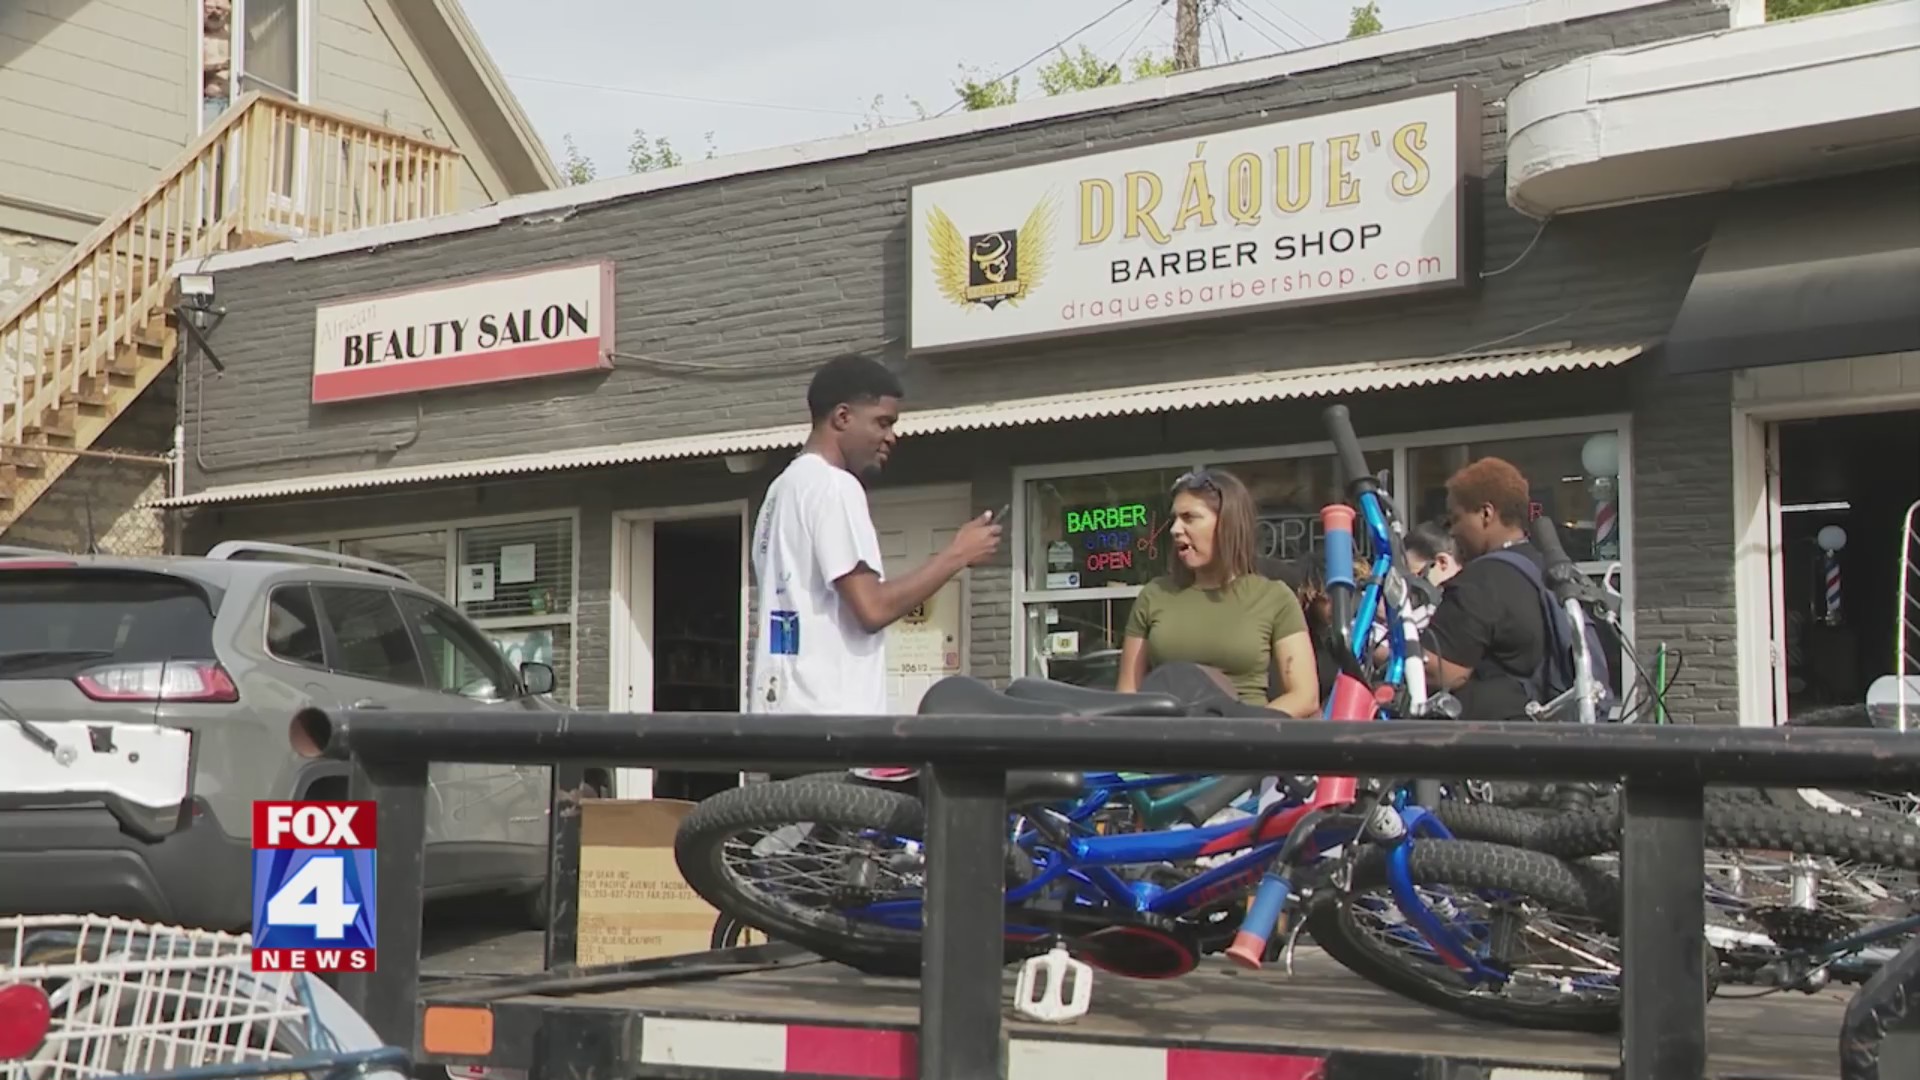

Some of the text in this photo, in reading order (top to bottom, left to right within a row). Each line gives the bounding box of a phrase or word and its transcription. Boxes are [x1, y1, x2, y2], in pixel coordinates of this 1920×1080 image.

[1077, 121, 1432, 246] DRÁQUE'S
[1110, 222, 1384, 285] BARBER SHOP
[1061, 254, 1443, 322] draquesbarbershop.com
[343, 299, 589, 368] BEAUTY SALON
[1066, 504, 1147, 533] BARBER
[1086, 550, 1132, 571] OPEN
